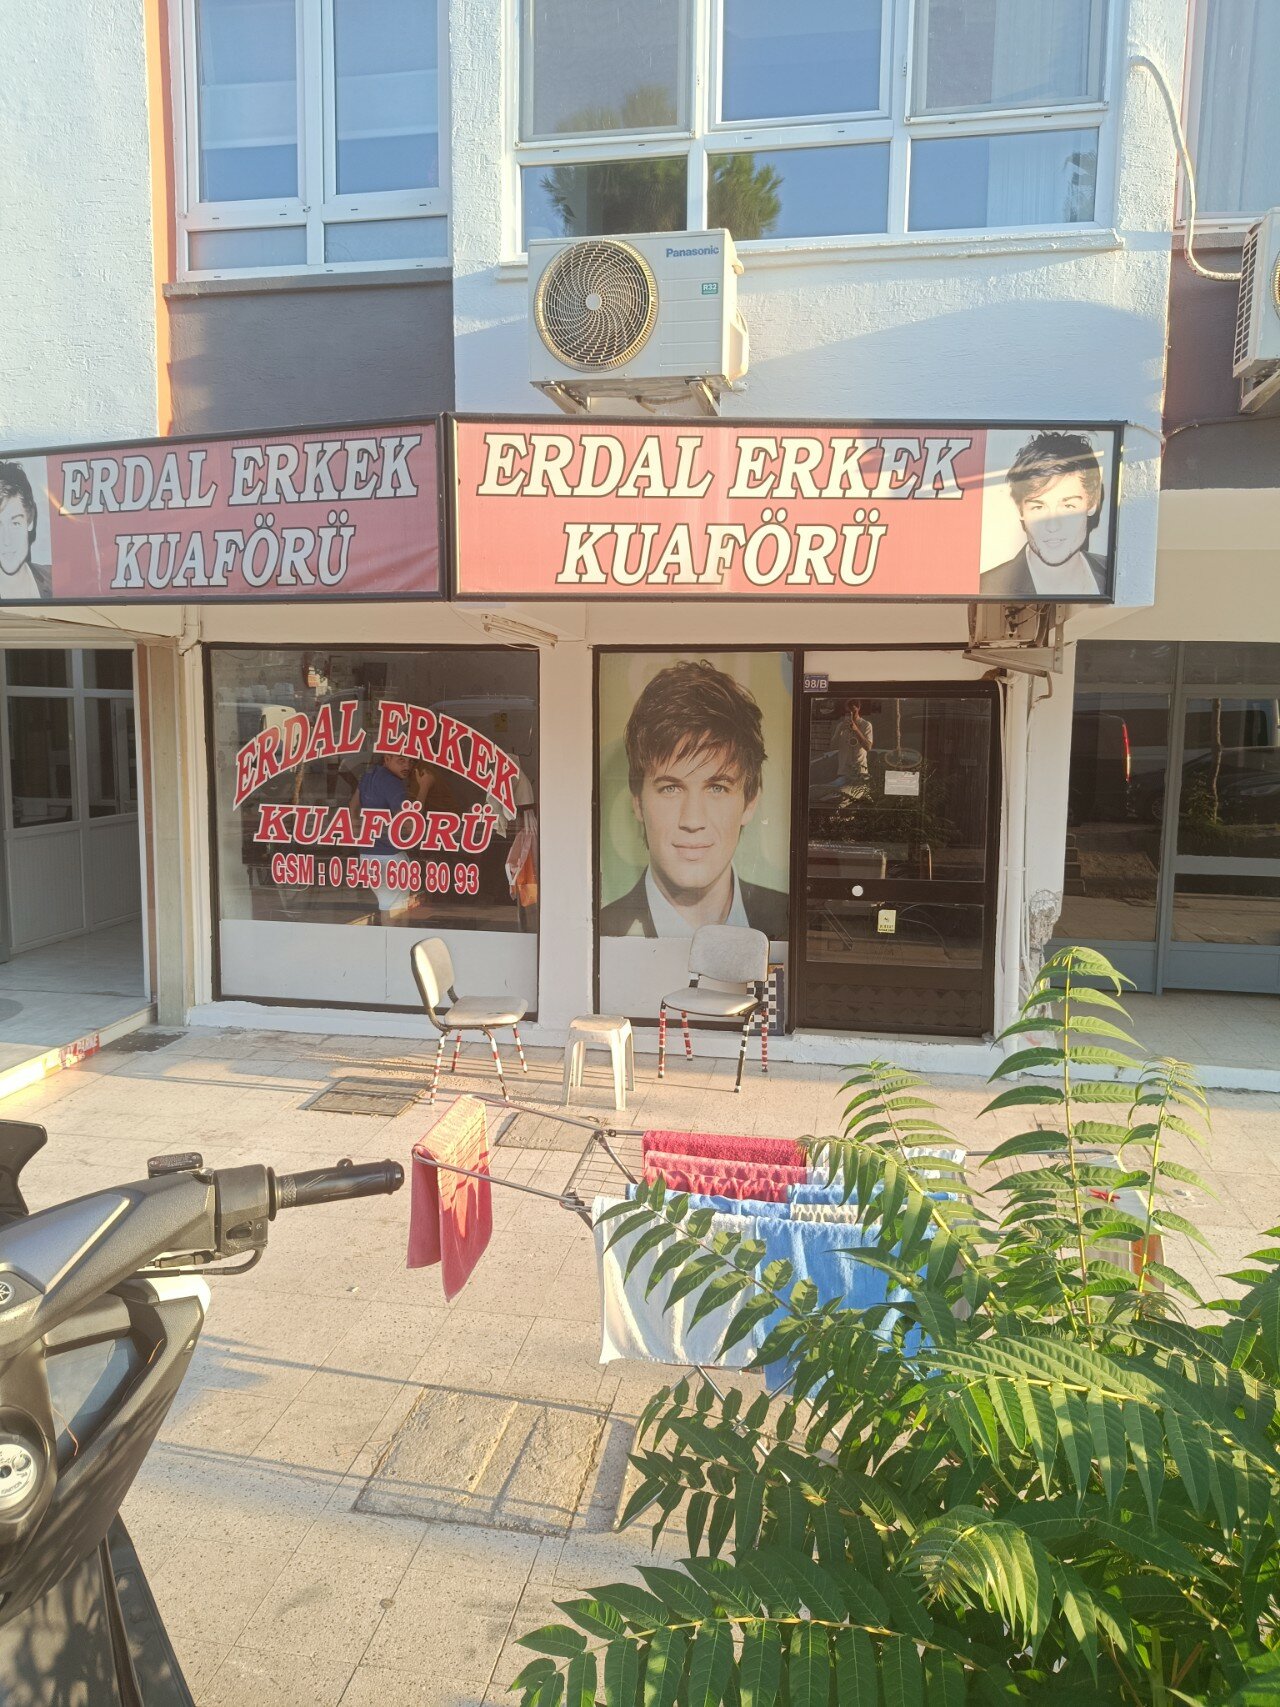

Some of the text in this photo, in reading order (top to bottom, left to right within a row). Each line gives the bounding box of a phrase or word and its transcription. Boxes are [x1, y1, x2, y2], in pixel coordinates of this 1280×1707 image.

[666, 245, 719, 257] Panasonic
[702, 283, 718, 291] R32
[58, 434, 422, 516] ERDAL ERKEK
[476, 432, 972, 500] ERDAL ERKEK
[110, 509, 356, 590] KUAFÖRÜ
[555, 508, 888, 587] KUAFÖRÜ
[804, 679, 827, 689] 98/B
[233, 700, 520, 820] ERDAL ERKEK
[253, 800, 499, 853] KUAFÖRÜ
[271, 852, 314, 885] GSM
[329, 856, 343, 887] 0
[346, 857, 382, 889] 543
[386, 859, 422, 892] 608
[425, 861, 450, 893] 80
[454, 863, 480, 895] 93
